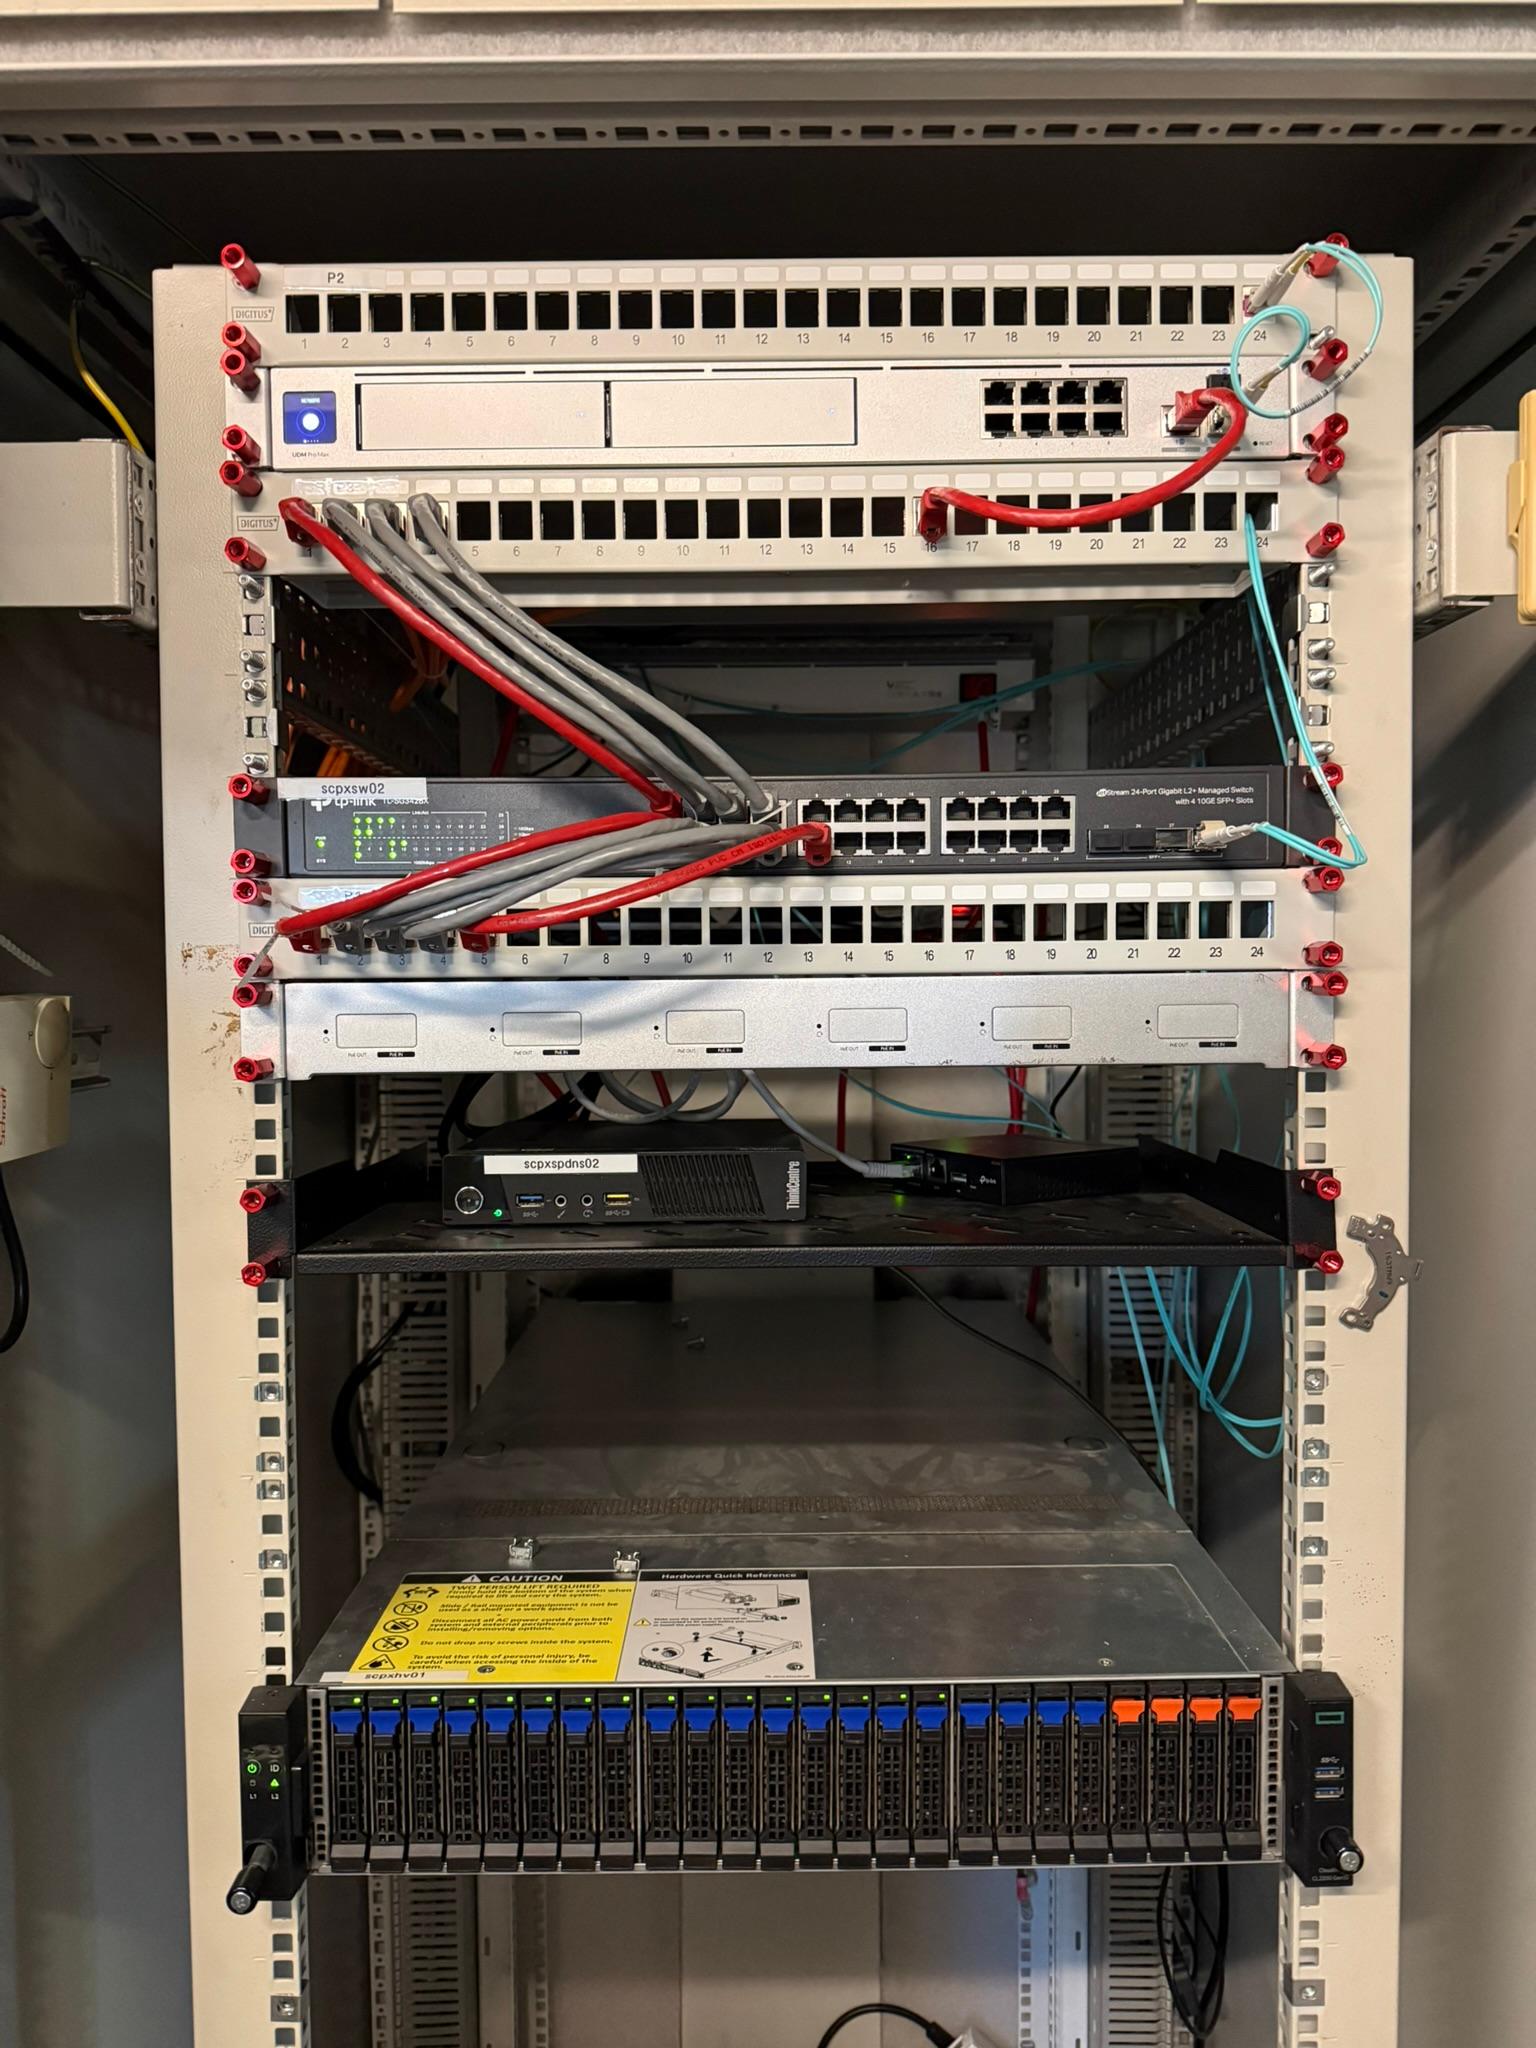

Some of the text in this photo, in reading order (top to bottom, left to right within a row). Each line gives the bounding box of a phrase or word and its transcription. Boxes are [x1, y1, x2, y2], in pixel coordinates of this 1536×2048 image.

[327, 272, 344, 284] P2
[301, 329, 1267, 349] 1 2 3 4 5 6 7 8 9 10 11 12 13 14 15 16 17 18 19 20 21 22 23 24
[471, 536, 1268, 557] 5 6 7 8 9 10 11 12 13 14 15 16 17 18 19 20 21 22 23 24
[321, 782, 385, 796] scpxsw02
[1131, 788, 1157, 796] 24-Port
[1158, 787, 1182, 796] Gigabit
[1183, 787, 1196, 795] L2+
[1198, 786, 1229, 795] Managed
[1230, 786, 1254, 794] Switch
[1197, 797, 1215, 805] 10GE
[521, 953, 529, 965] 6
[562, 953, 569, 965] 7
[603, 952, 610, 965] 8
[643, 952, 650, 965] 9
[682, 952, 693, 964] 10
[723, 952, 732, 963] 11
[763, 951, 773, 963] 12
[803, 950, 814, 963] 13
[843, 951, 854, 962] 14
[884, 950, 894, 962] 15
[924, 949, 935, 961] 16
[964, 949, 975, 961] 17
[1005, 948, 1016, 961] 18
[1046, 948, 1057, 960] 19
[1086, 947, 1098, 960] 20
[1127, 947, 1139, 959] 21
[1167, 947, 1181, 958] 22
[1209, 946, 1223, 958] 23
[1250, 946, 1264, 958] 24
[524, 1158, 600, 1170] scpxspdns02
[786, 1161, 800, 1210] ThinkCentre
[364, 1672, 425, 1680] scpxhv01
[270, 1764, 279, 1772] ID
